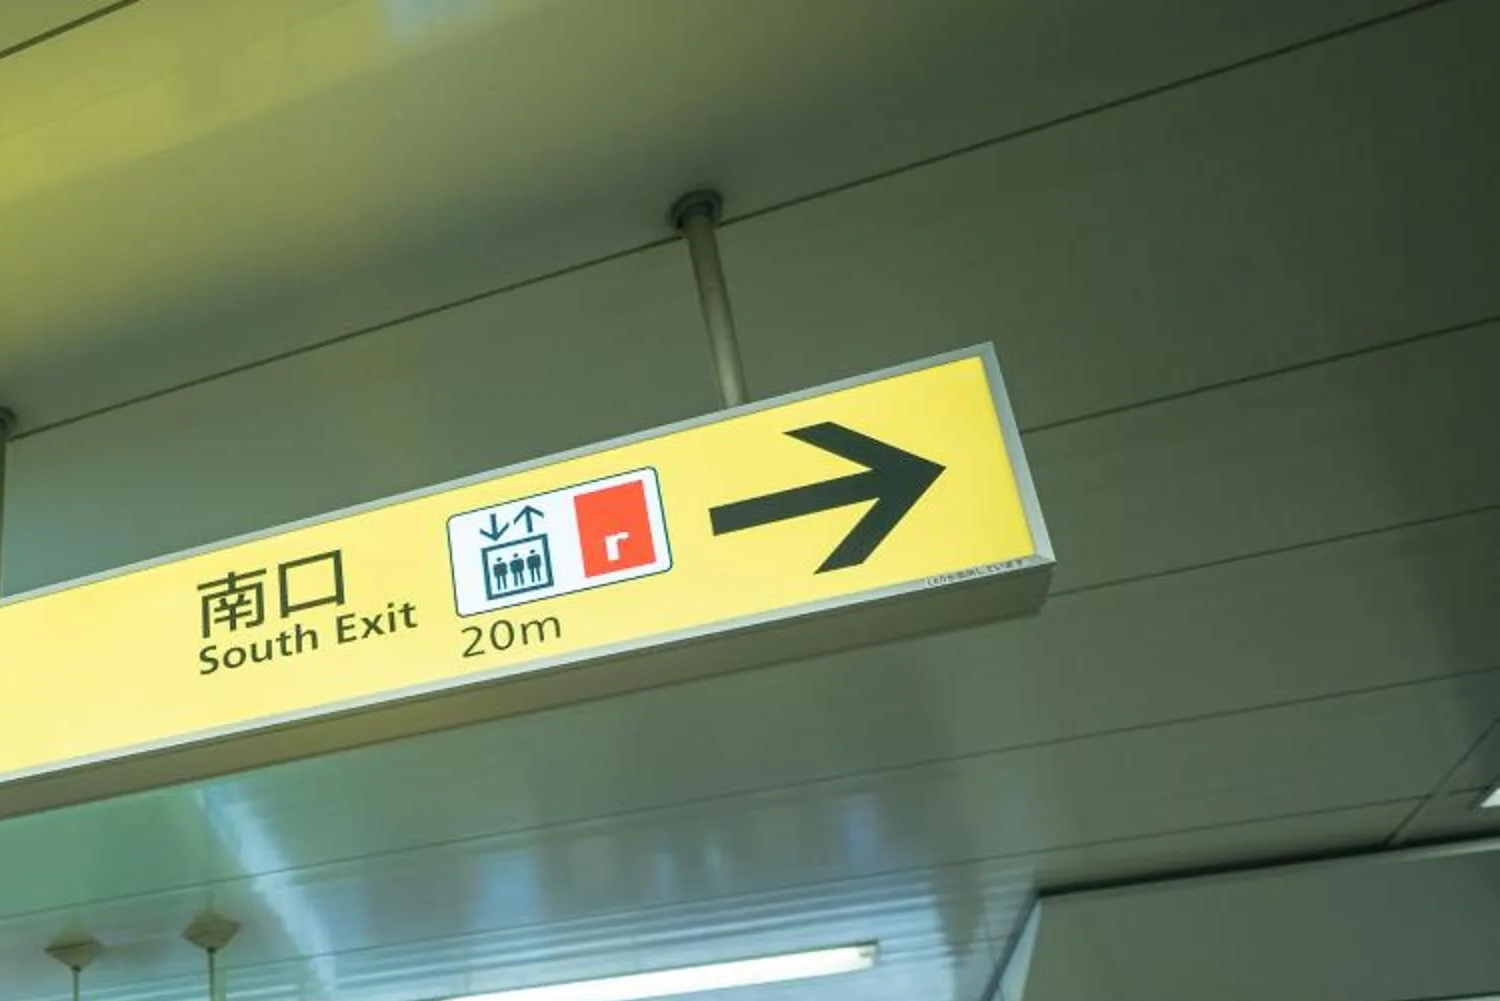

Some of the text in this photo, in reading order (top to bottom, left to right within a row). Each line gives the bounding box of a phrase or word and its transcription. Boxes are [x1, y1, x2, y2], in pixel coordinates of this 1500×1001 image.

[197, 549, 345, 638] 南口
[199, 602, 418, 675] South Exit
[460, 616, 562, 659] 20m
